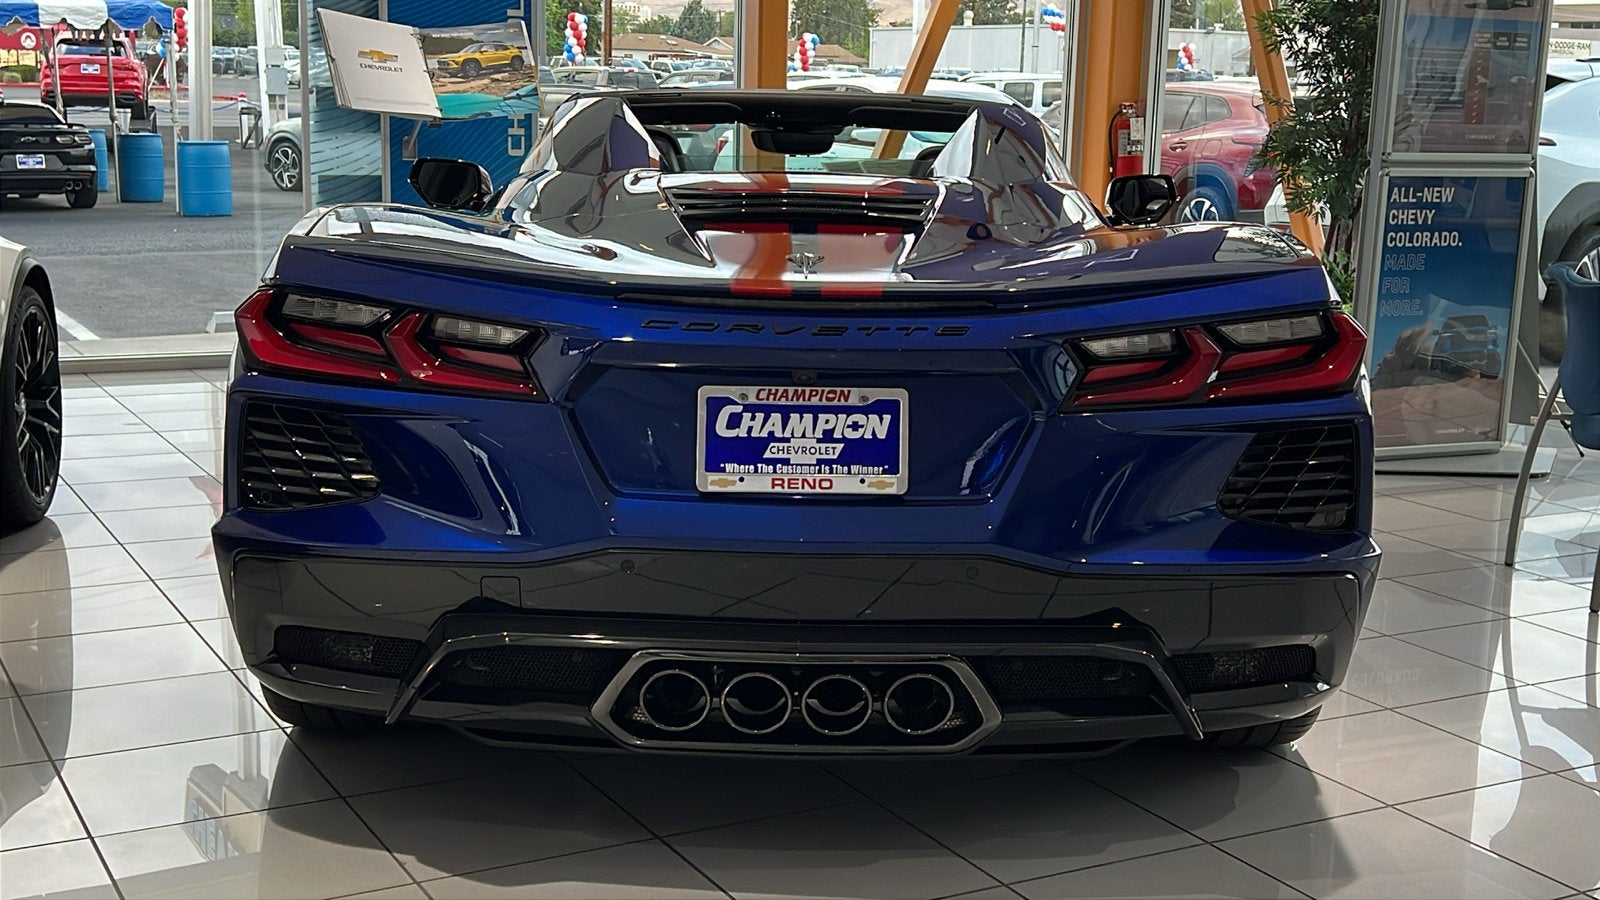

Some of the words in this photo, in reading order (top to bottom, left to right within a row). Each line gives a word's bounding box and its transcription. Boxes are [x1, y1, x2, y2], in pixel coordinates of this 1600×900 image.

[359, 62, 403, 73] CHEVROLET
[1390, 186, 1455, 203] ALL-NEW
[1388, 209, 1436, 225] CHEVY
[1386, 231, 1463, 247] COLORADO.
[1384, 253, 1426, 271] MADE
[1381, 276, 1410, 294] FOR
[1379, 299, 1424, 317] MORE.
[640, 319, 972, 337] CORVETTE
[755, 388, 852, 403] CHAMPION
[715, 404, 892, 440] CHAMPION
[769, 445, 838, 456] CHEVROLET
[757, 463, 774, 474] The
[776, 464, 819, 475] Customer
[821, 464, 830, 475] Is
[832, 464, 849, 475] The
[771, 477, 834, 490] RENO
